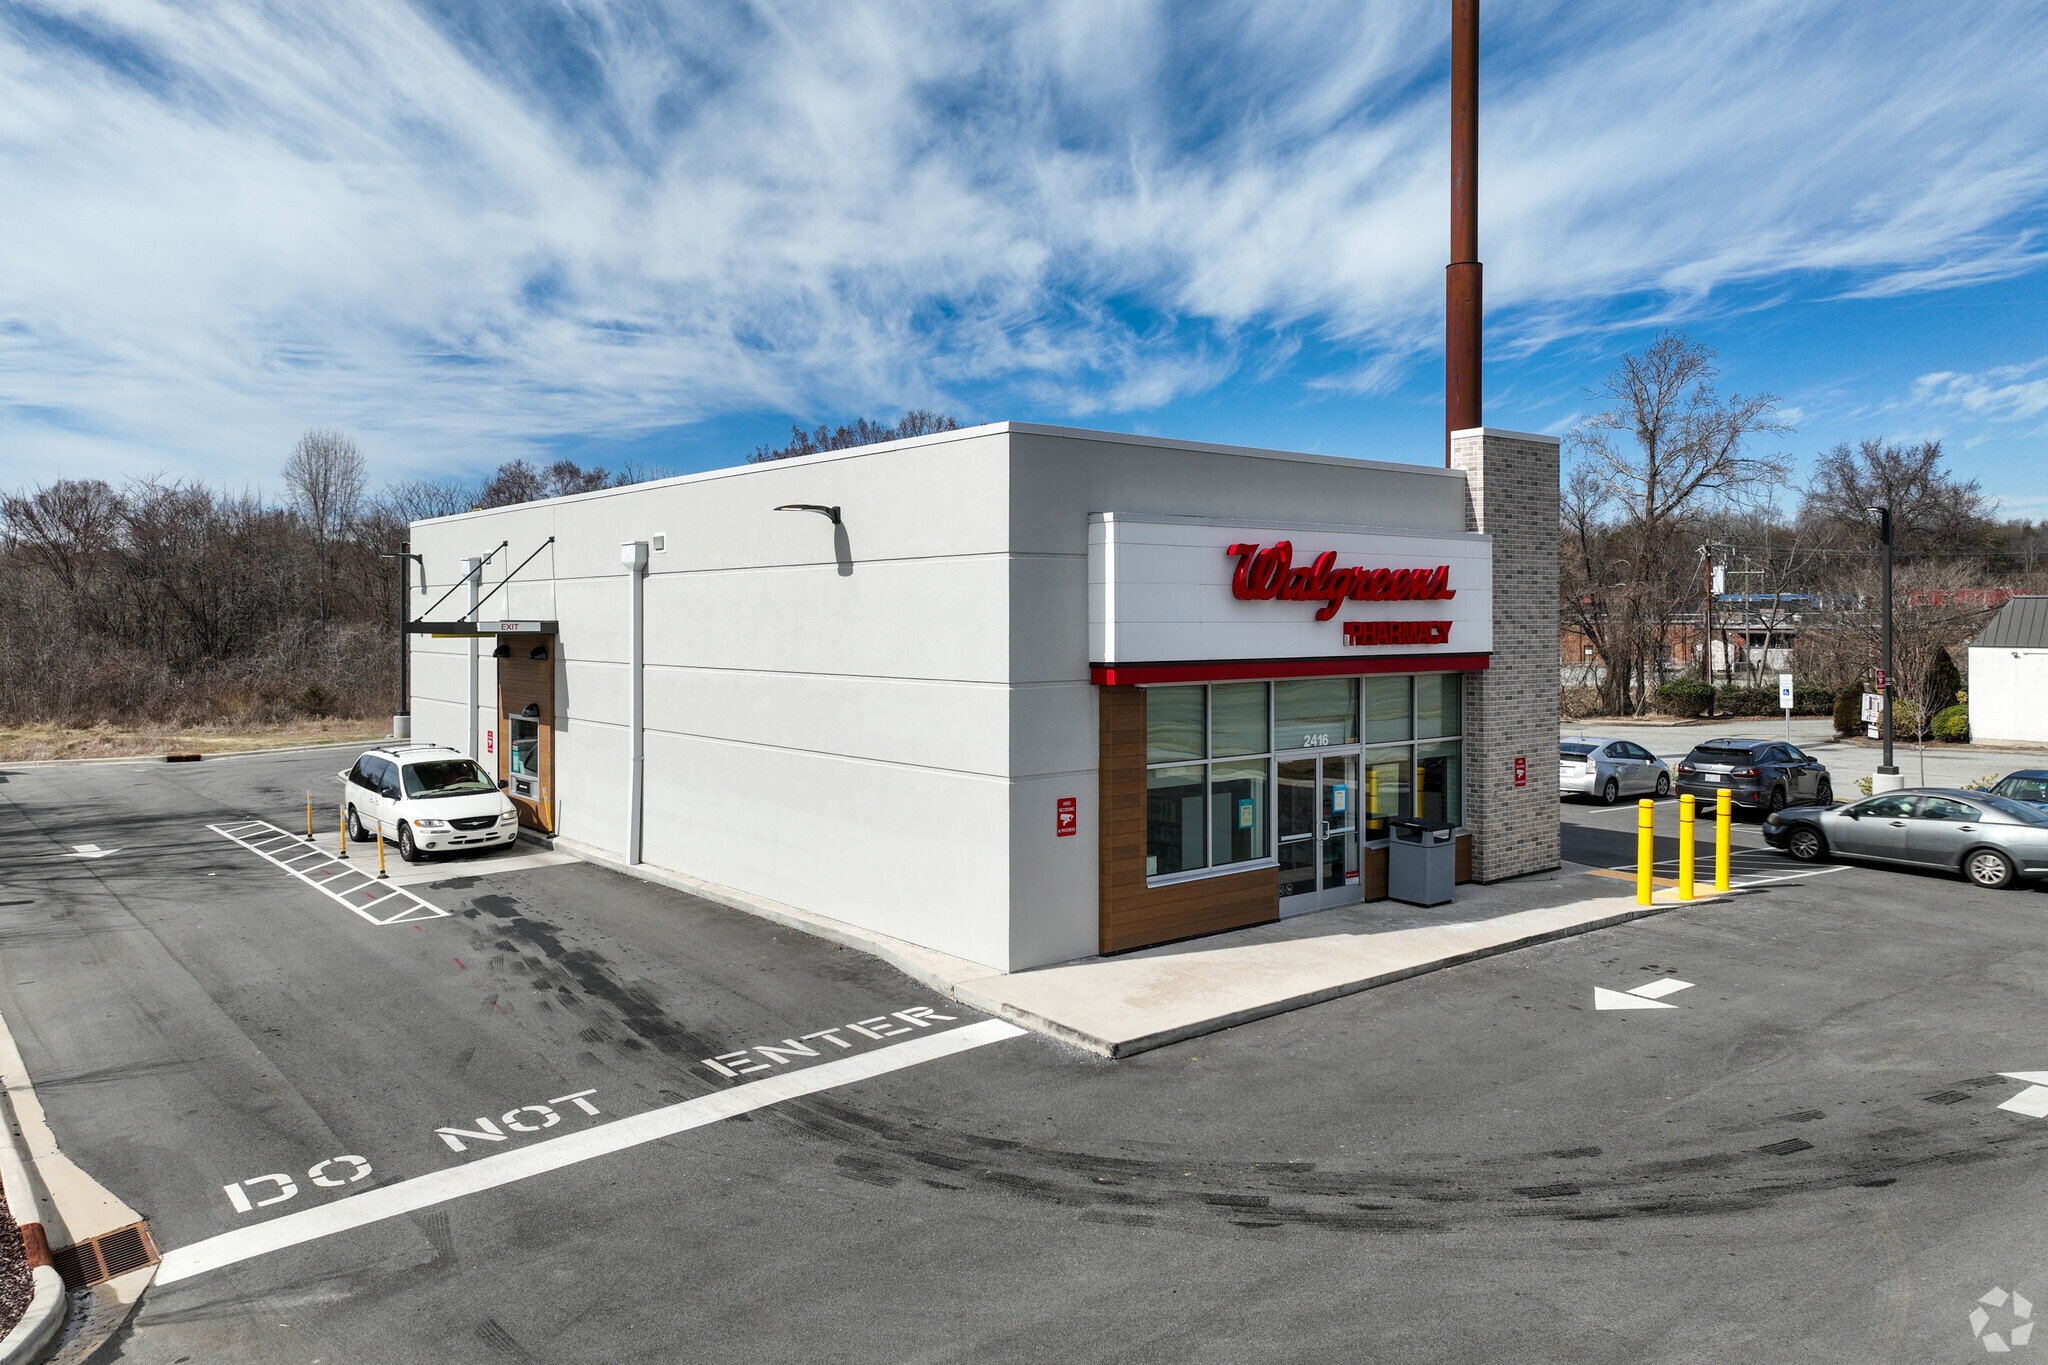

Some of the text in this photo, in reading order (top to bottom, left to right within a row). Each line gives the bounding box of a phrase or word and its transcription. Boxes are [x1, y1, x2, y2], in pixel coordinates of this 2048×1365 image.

[1226, 540, 1456, 621] Walgreens
[501, 623, 519, 631] EXIT
[1343, 621, 1453, 646] PHARMACY
[1303, 733, 1329, 747] 2416
[223, 1006, 957, 1213] DO NOT ENTER
